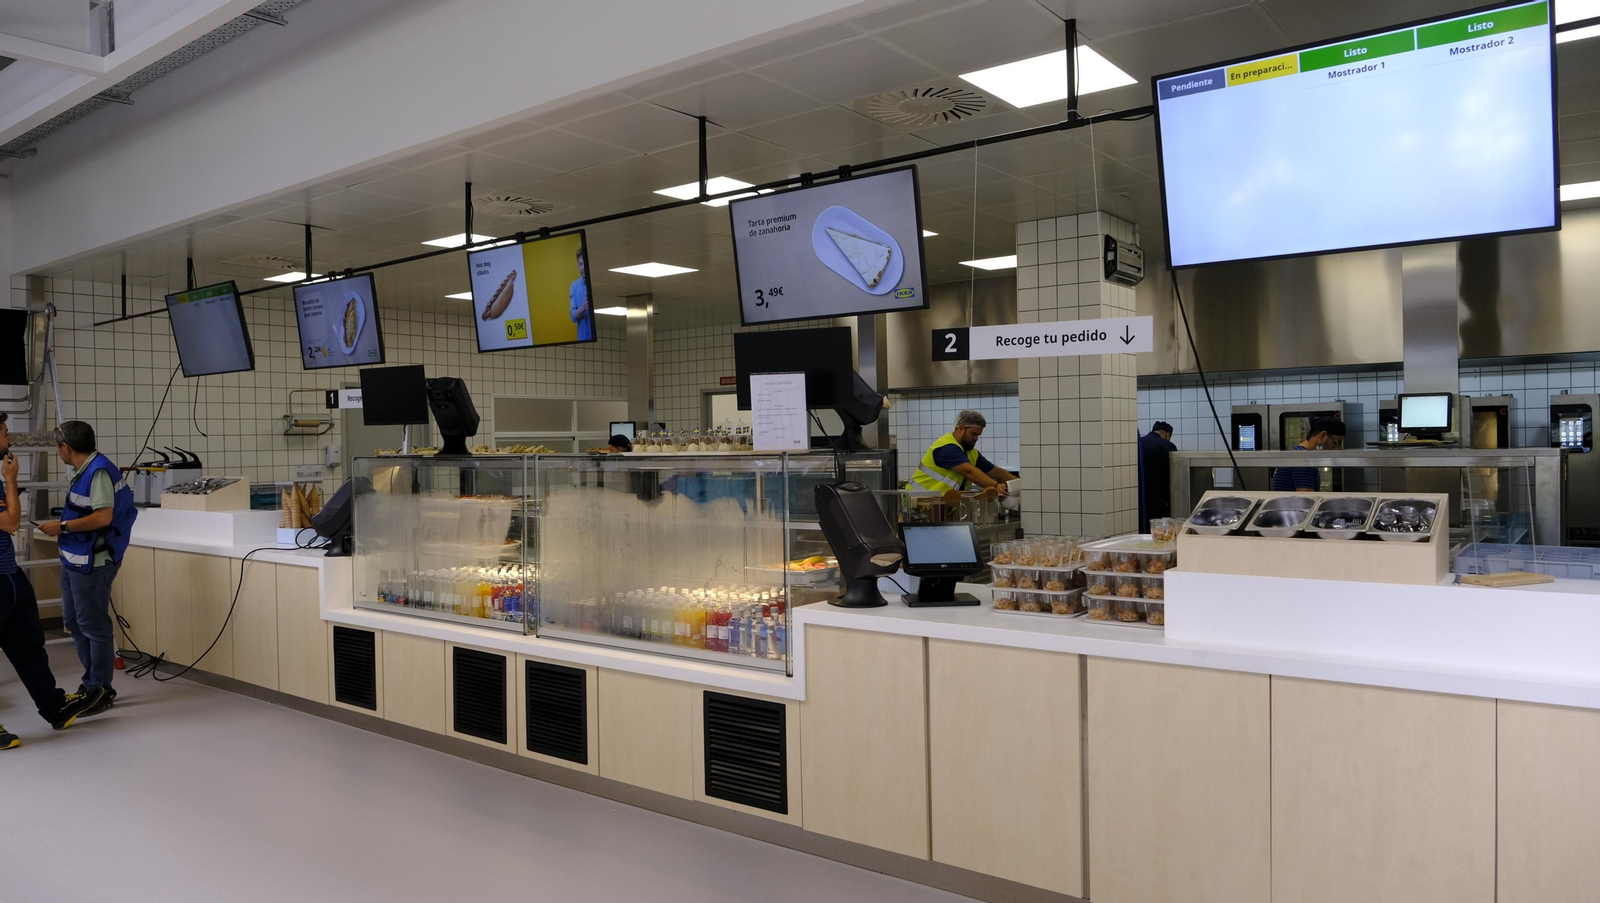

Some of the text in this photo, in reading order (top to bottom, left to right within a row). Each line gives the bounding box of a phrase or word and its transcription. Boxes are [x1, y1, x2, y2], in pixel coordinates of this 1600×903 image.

[1467, 20, 1494, 33] Listo
[1343, 46, 1368, 58] Listo
[1449, 36, 1514, 56] Mostrador 2
[1230, 62, 1293, 80] En preparaci...
[1328, 61, 1386, 79] Mostrador 1
[1171, 78, 1213, 93] Pendiente
[747, 212, 797, 228] Tarta premium
[748, 223, 791, 237] de zanahoria
[483, 261, 491, 269] dog
[895, 289, 914, 297] IKEA
[944, 329, 1107, 353] 2 Recoge tu pedido
[330, 392, 334, 404] 1
